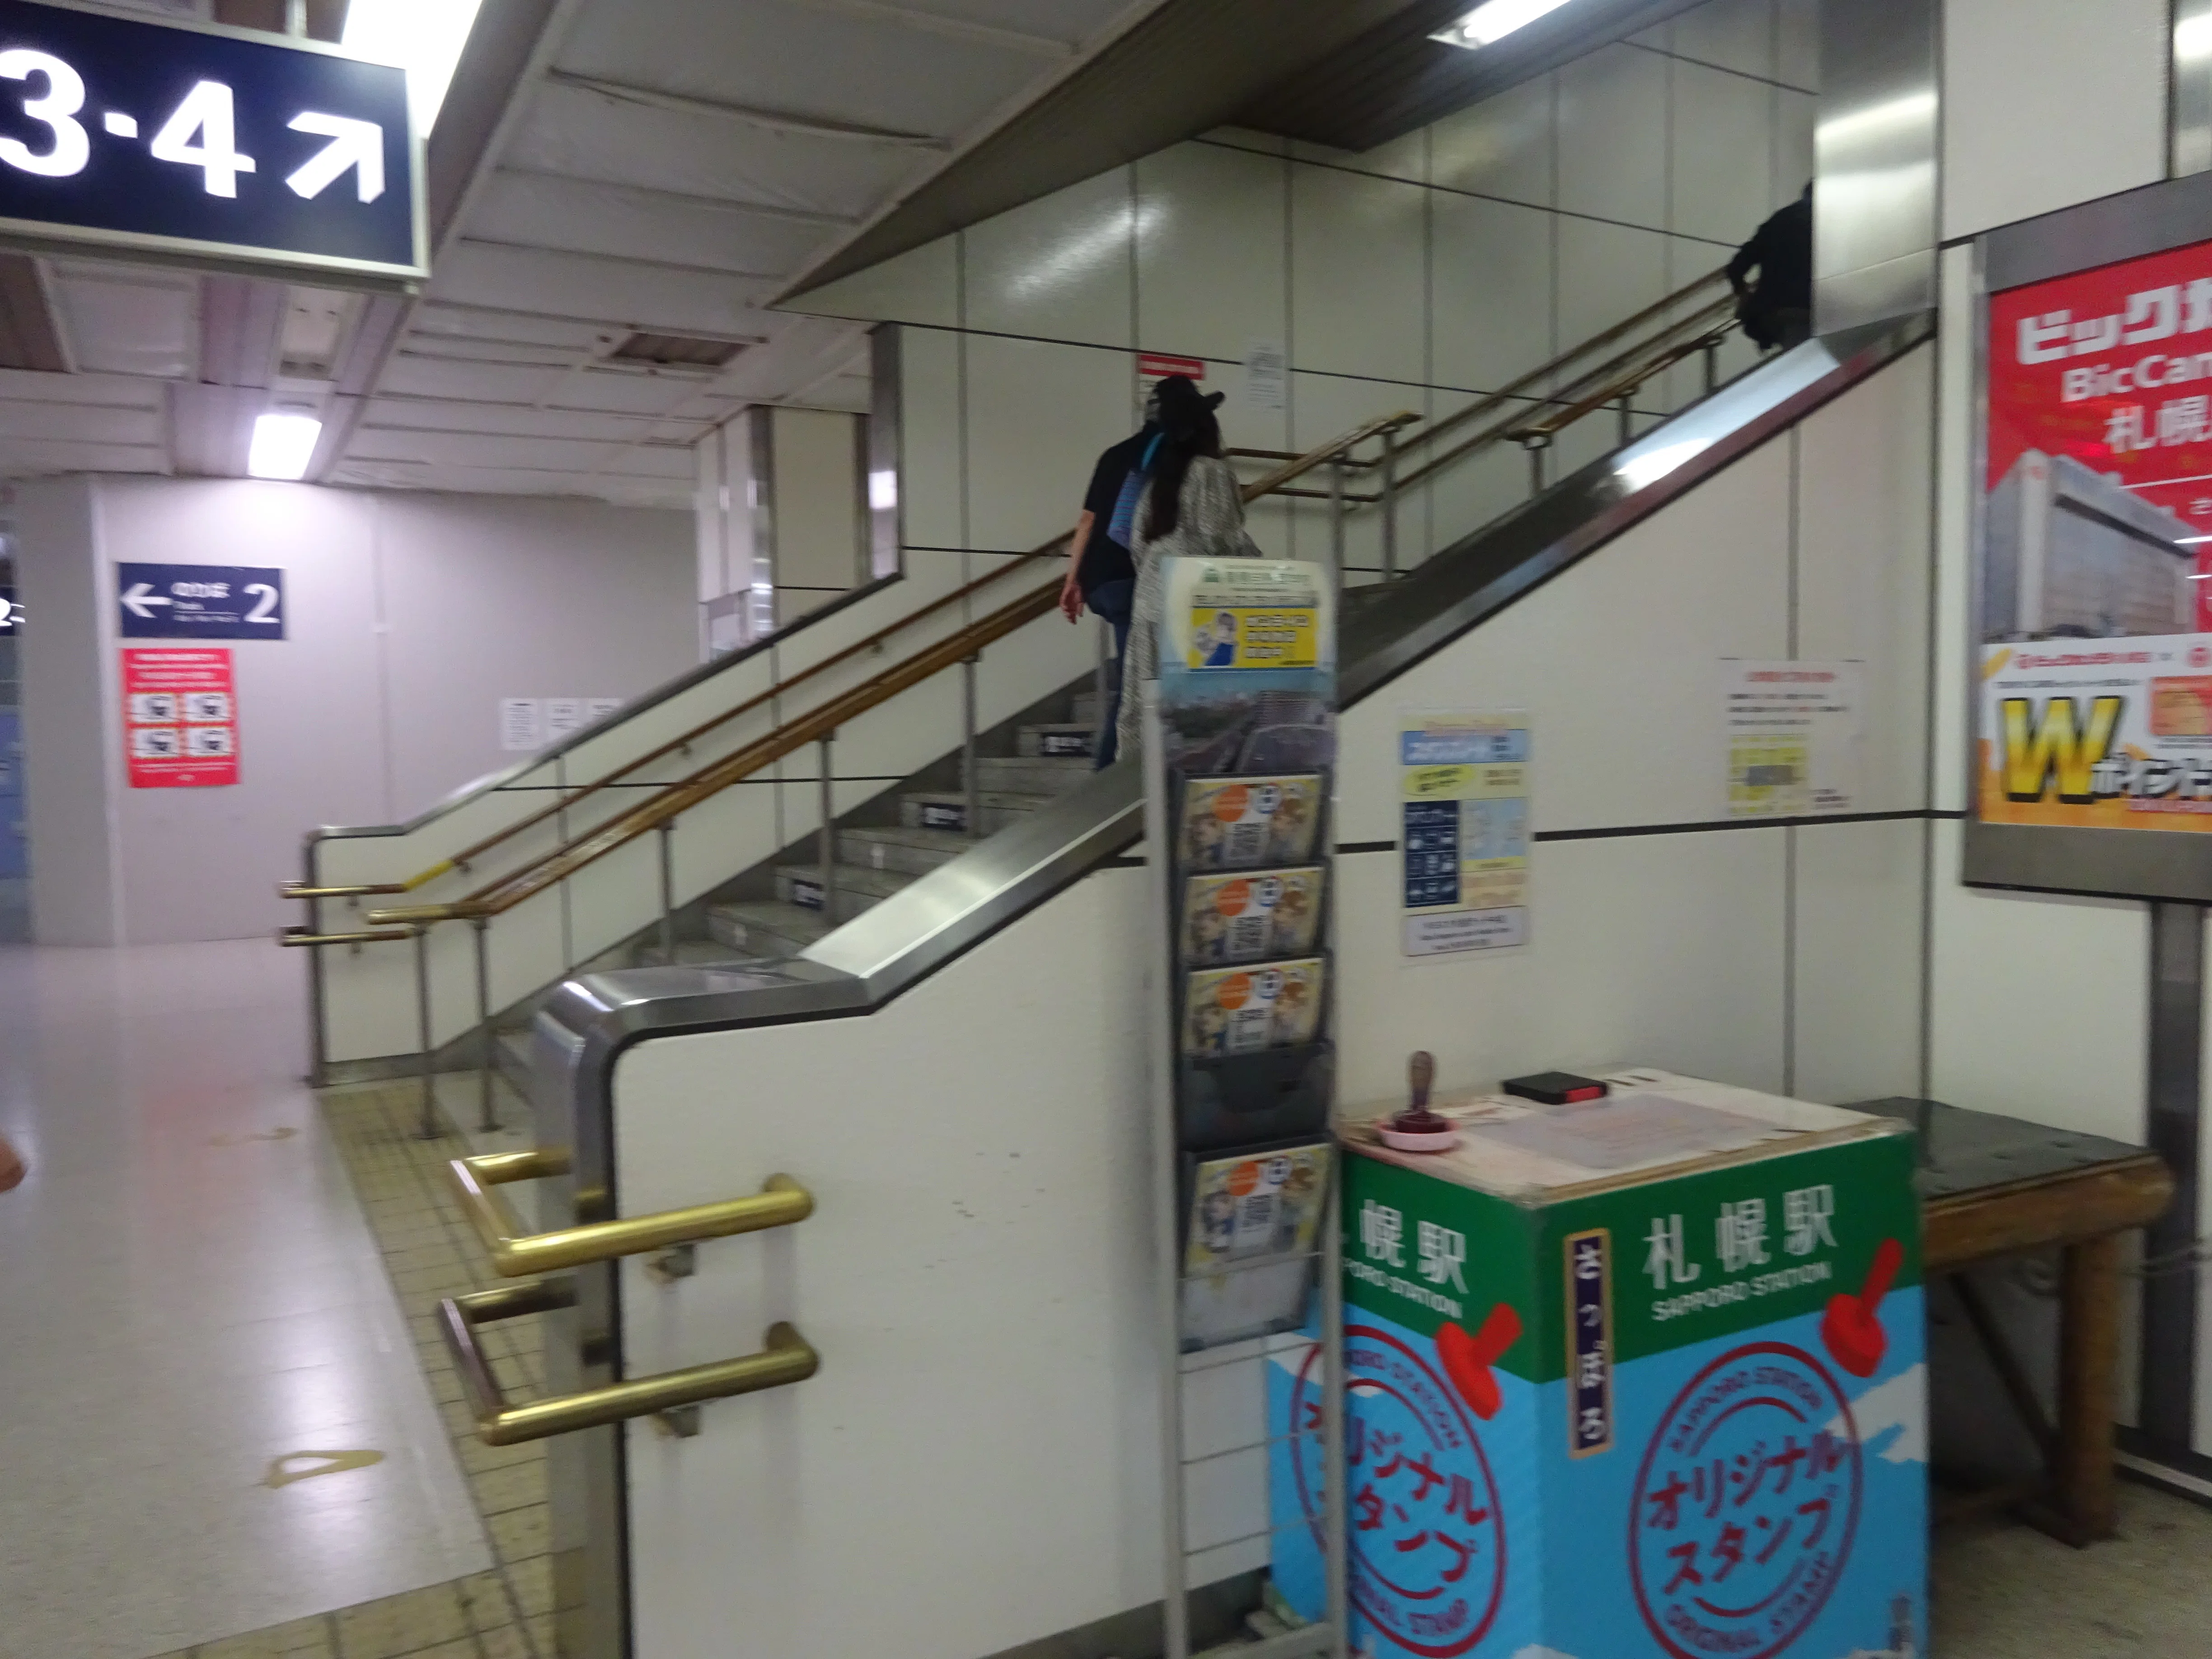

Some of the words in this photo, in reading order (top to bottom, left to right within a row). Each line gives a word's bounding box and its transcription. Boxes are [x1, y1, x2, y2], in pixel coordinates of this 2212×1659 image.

[244, 583, 281, 623] 2
[1358, 1198, 1470, 1294] 幌駅
[1642, 1183, 1840, 1290] 札幌駅
[1647, 1429, 1849, 1530] オリジナル
[1663, 1484, 1839, 1595] スタンプ
